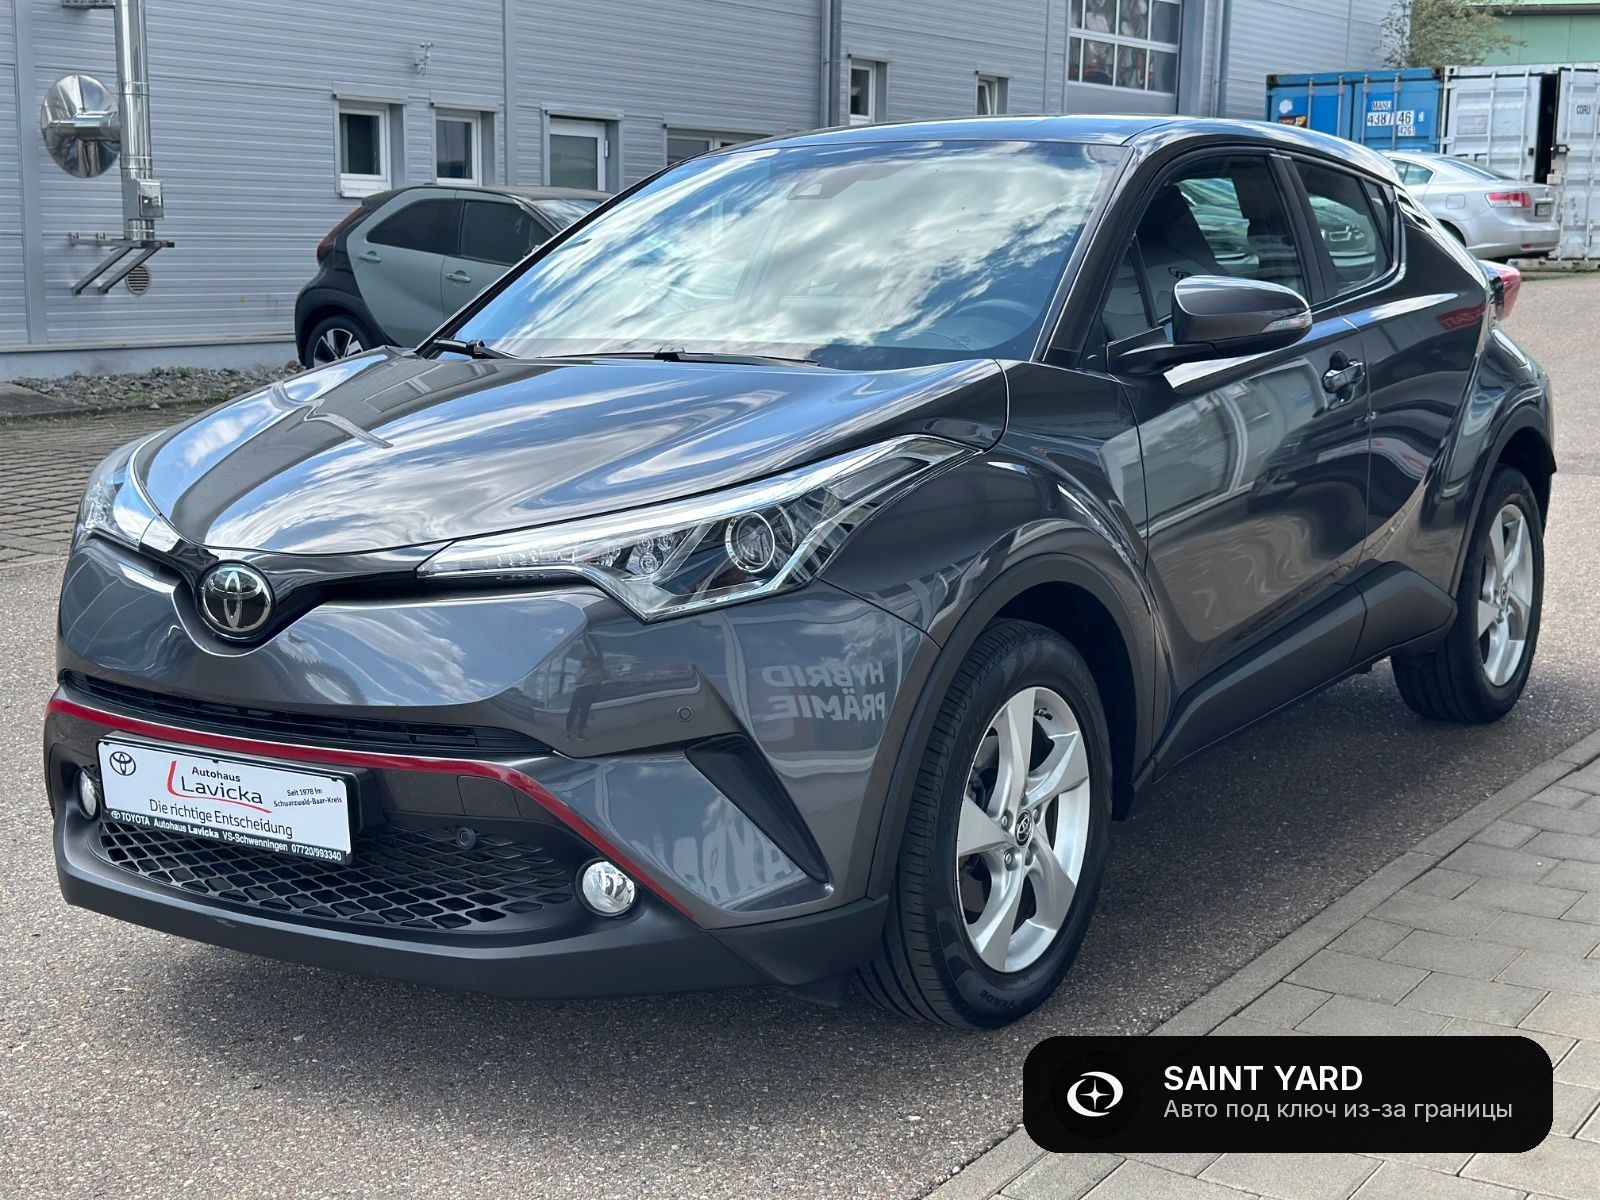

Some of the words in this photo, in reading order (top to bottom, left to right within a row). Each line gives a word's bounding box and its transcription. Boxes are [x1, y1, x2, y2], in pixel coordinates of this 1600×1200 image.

[191, 766, 241, 783] Autohaus
[181, 776, 263, 805] Lavicka
[300, 788, 314, 796] 1978
[149, 799, 169, 814] Die
[170, 803, 213, 823] richtige
[215, 810, 293, 839] Entscheidung
[121, 812, 151, 826] TOYOTA
[154, 819, 187, 833] Autohaus
[188, 824, 219, 839] Lavicka
[222, 830, 288, 852] VS-Schwenningen
[291, 843, 342, 861] 07720/993340
